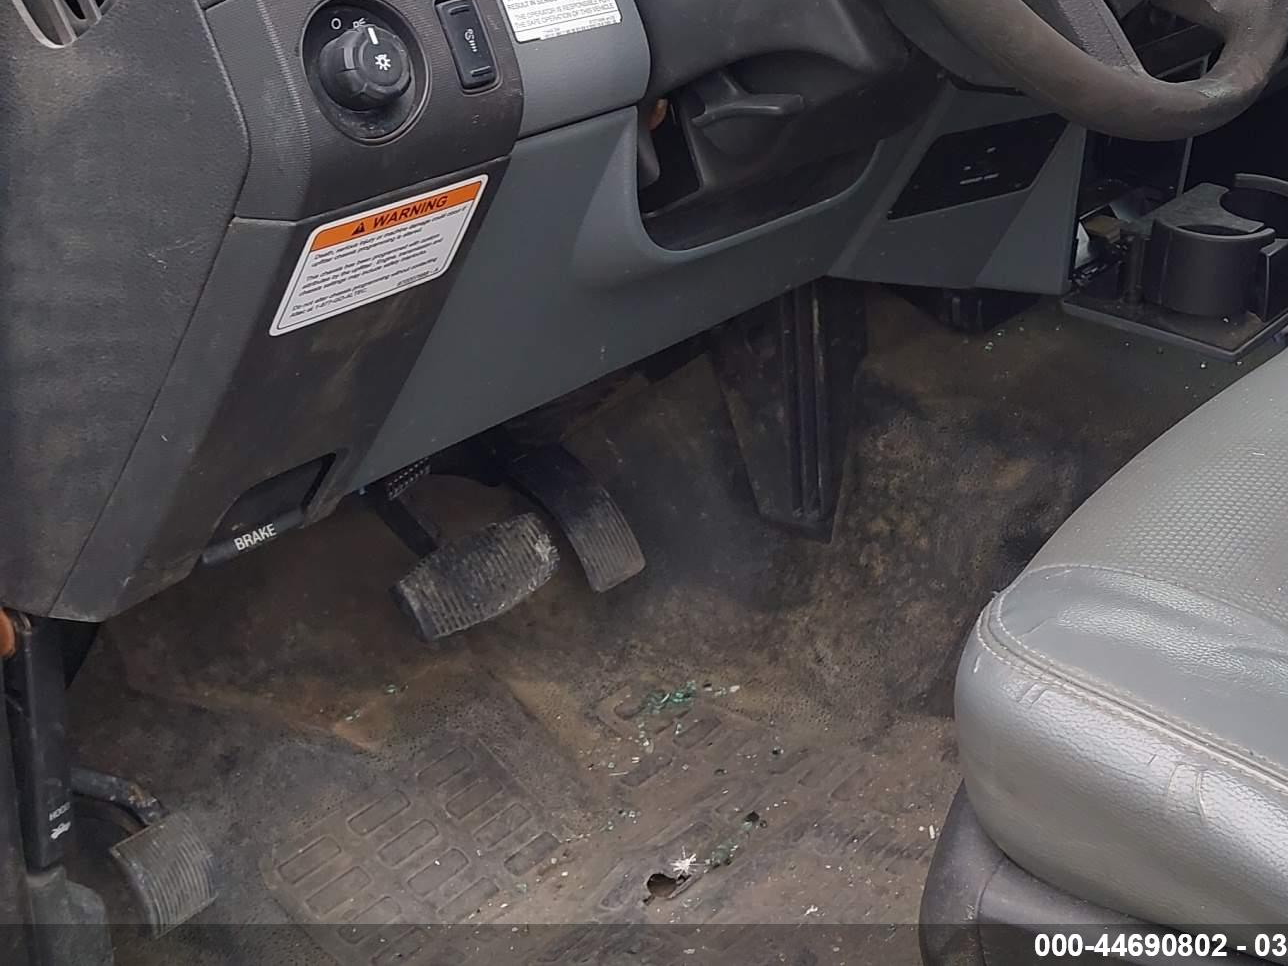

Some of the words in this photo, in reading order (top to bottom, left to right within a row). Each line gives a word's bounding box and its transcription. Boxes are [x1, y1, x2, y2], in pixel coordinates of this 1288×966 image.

[373, 196, 449, 226] WARNING
[233, 523, 278, 552] BRAKE
[48, 801, 71, 822] HOOD
